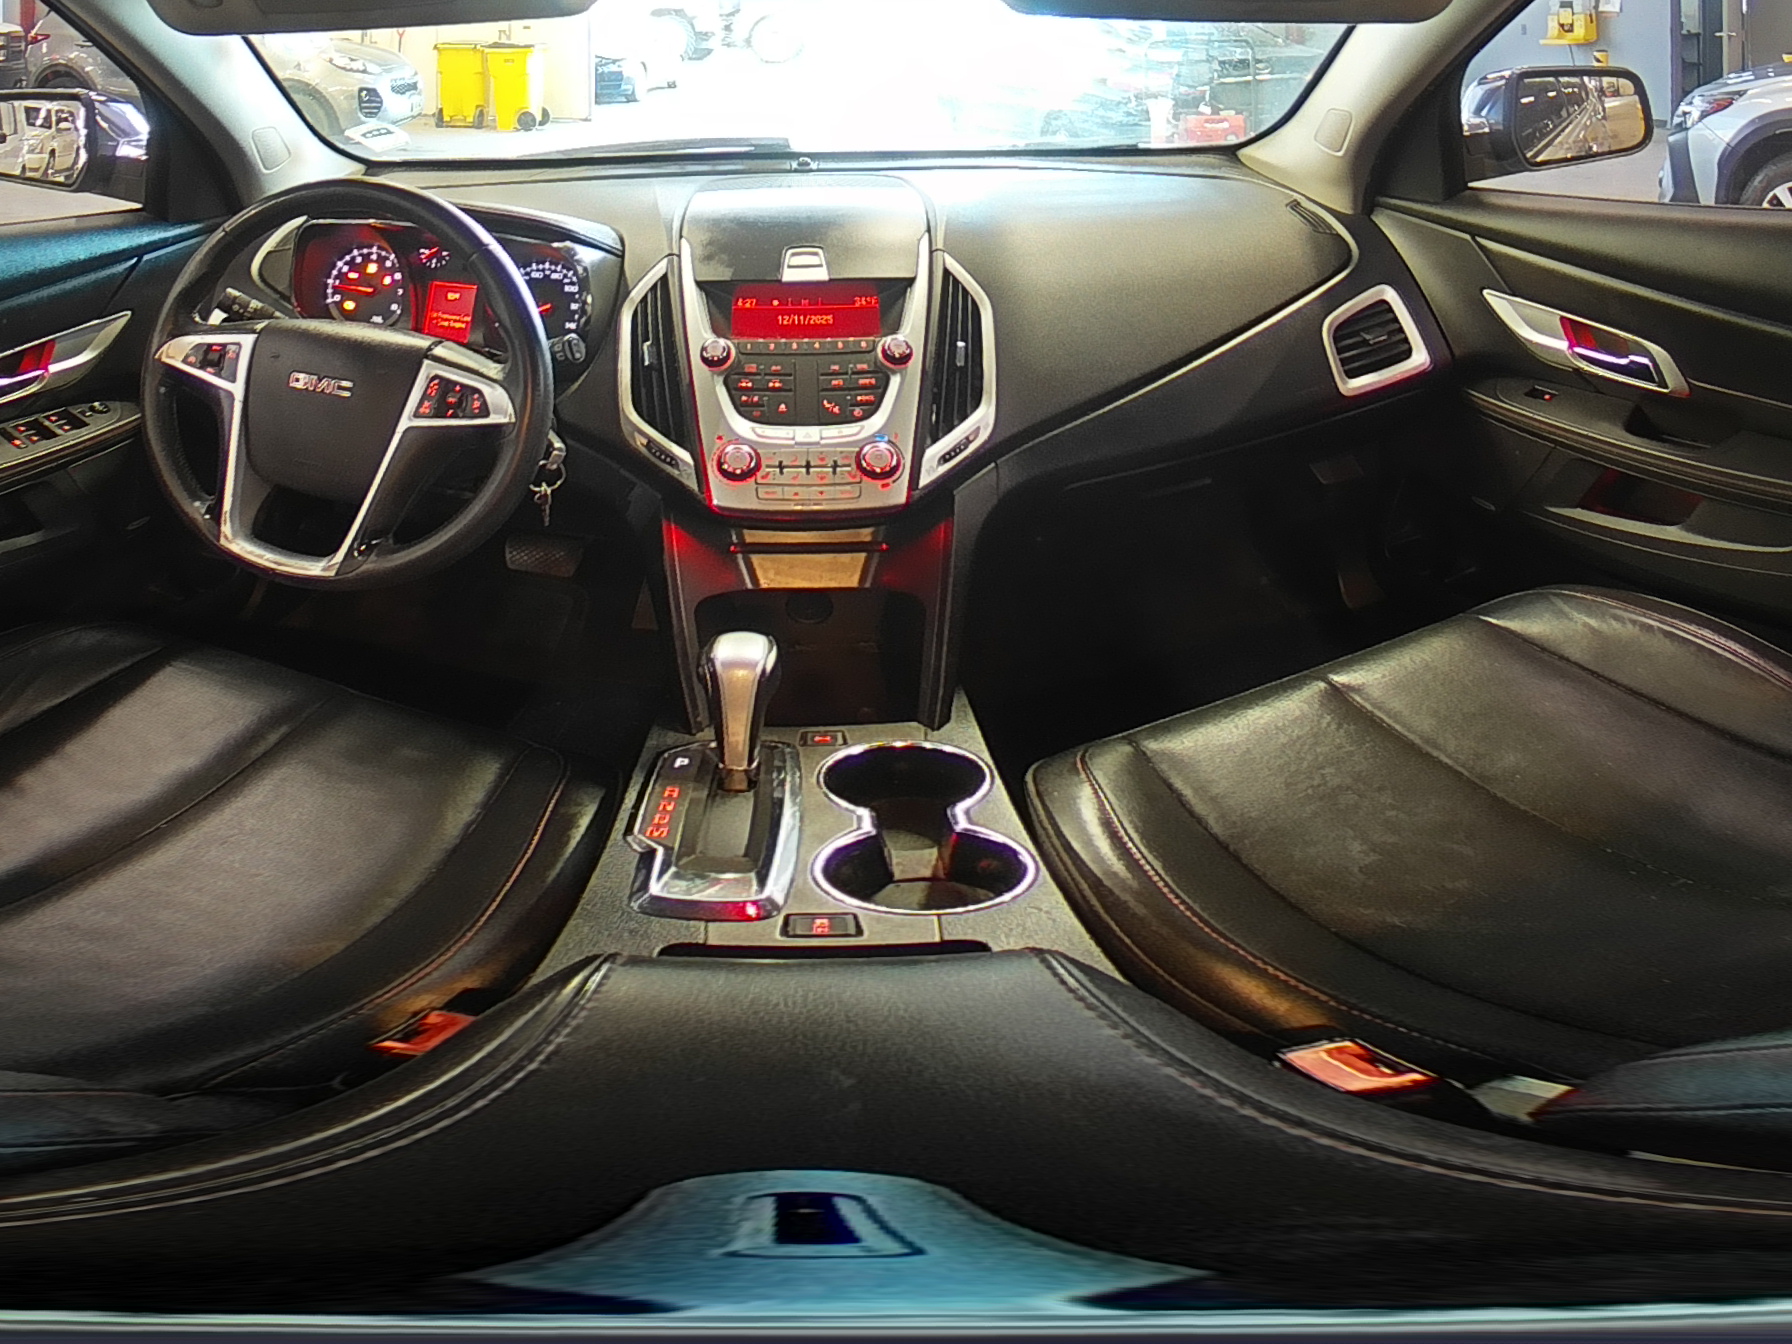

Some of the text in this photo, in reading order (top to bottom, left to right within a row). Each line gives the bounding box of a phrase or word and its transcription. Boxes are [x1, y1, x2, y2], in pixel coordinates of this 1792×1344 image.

[777, 314, 834, 325] 12/11/2025
[289, 370, 354, 398] GMC
[674, 757, 690, 768] P
[664, 787, 680, 798] R
[659, 800, 675, 811] N
[652, 813, 670, 824] D
